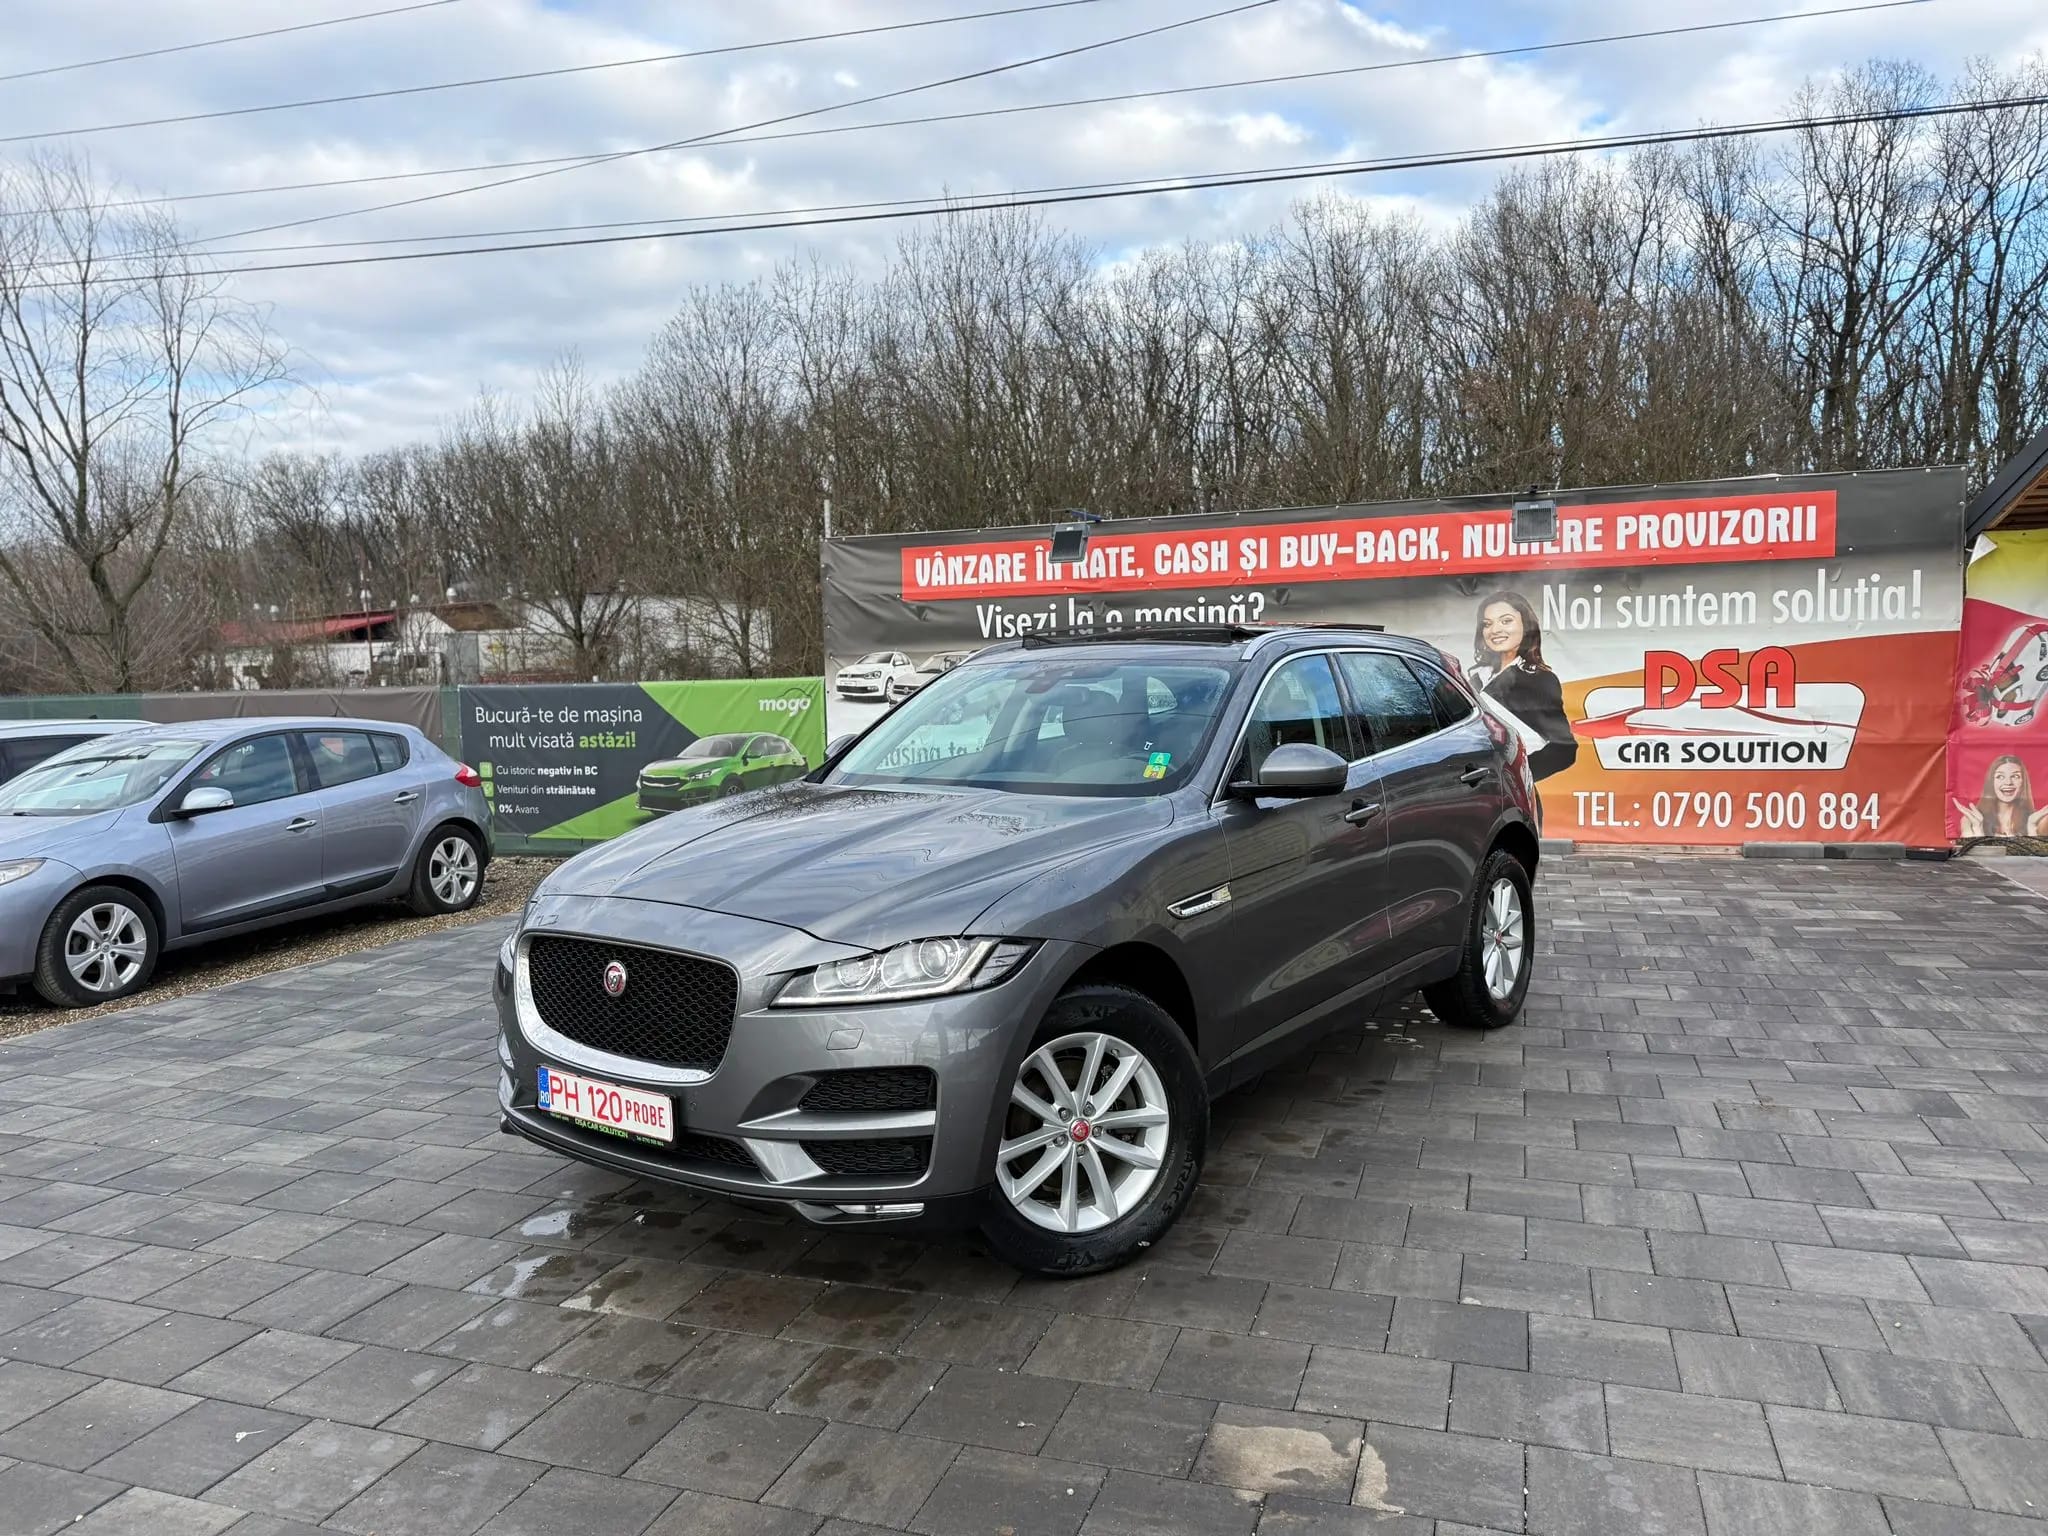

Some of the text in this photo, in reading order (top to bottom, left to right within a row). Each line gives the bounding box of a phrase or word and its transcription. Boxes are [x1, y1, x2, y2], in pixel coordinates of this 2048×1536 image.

[915, 550, 1026, 587] VÂNZARE
[1072, 546, 1144, 579] RATE,
[1154, 540, 1229, 575] CASH
[1239, 537, 1268, 578] ȘI
[1280, 526, 1450, 569] BUY-BACK,
[1616, 505, 1817, 551] PROVIZORII
[1543, 568, 1922, 631] Noi suntem soluția!
[976, 602, 1057, 639] Visezi
[1644, 646, 1796, 710] DSA
[475, 705, 643, 727] Bucură-te de mașina
[758, 697, 812, 718] mogo
[489, 730, 637, 748] mult visată astăzi!
[1618, 740, 1828, 764] CAR SOLUTION
[496, 765, 509, 775] Cu
[510, 765, 536, 775] istoric
[537, 765, 572, 777] negativ
[584, 765, 599, 775] BC
[496, 784, 597, 795] Venituri din străinătate
[498, 804, 540, 814] 0% Avans
[1572, 791, 1881, 830] TEL.: 0790 500 884
[540, 1090, 550, 1103] RO
[550, 1075, 666, 1128] PH 120 PROBE
